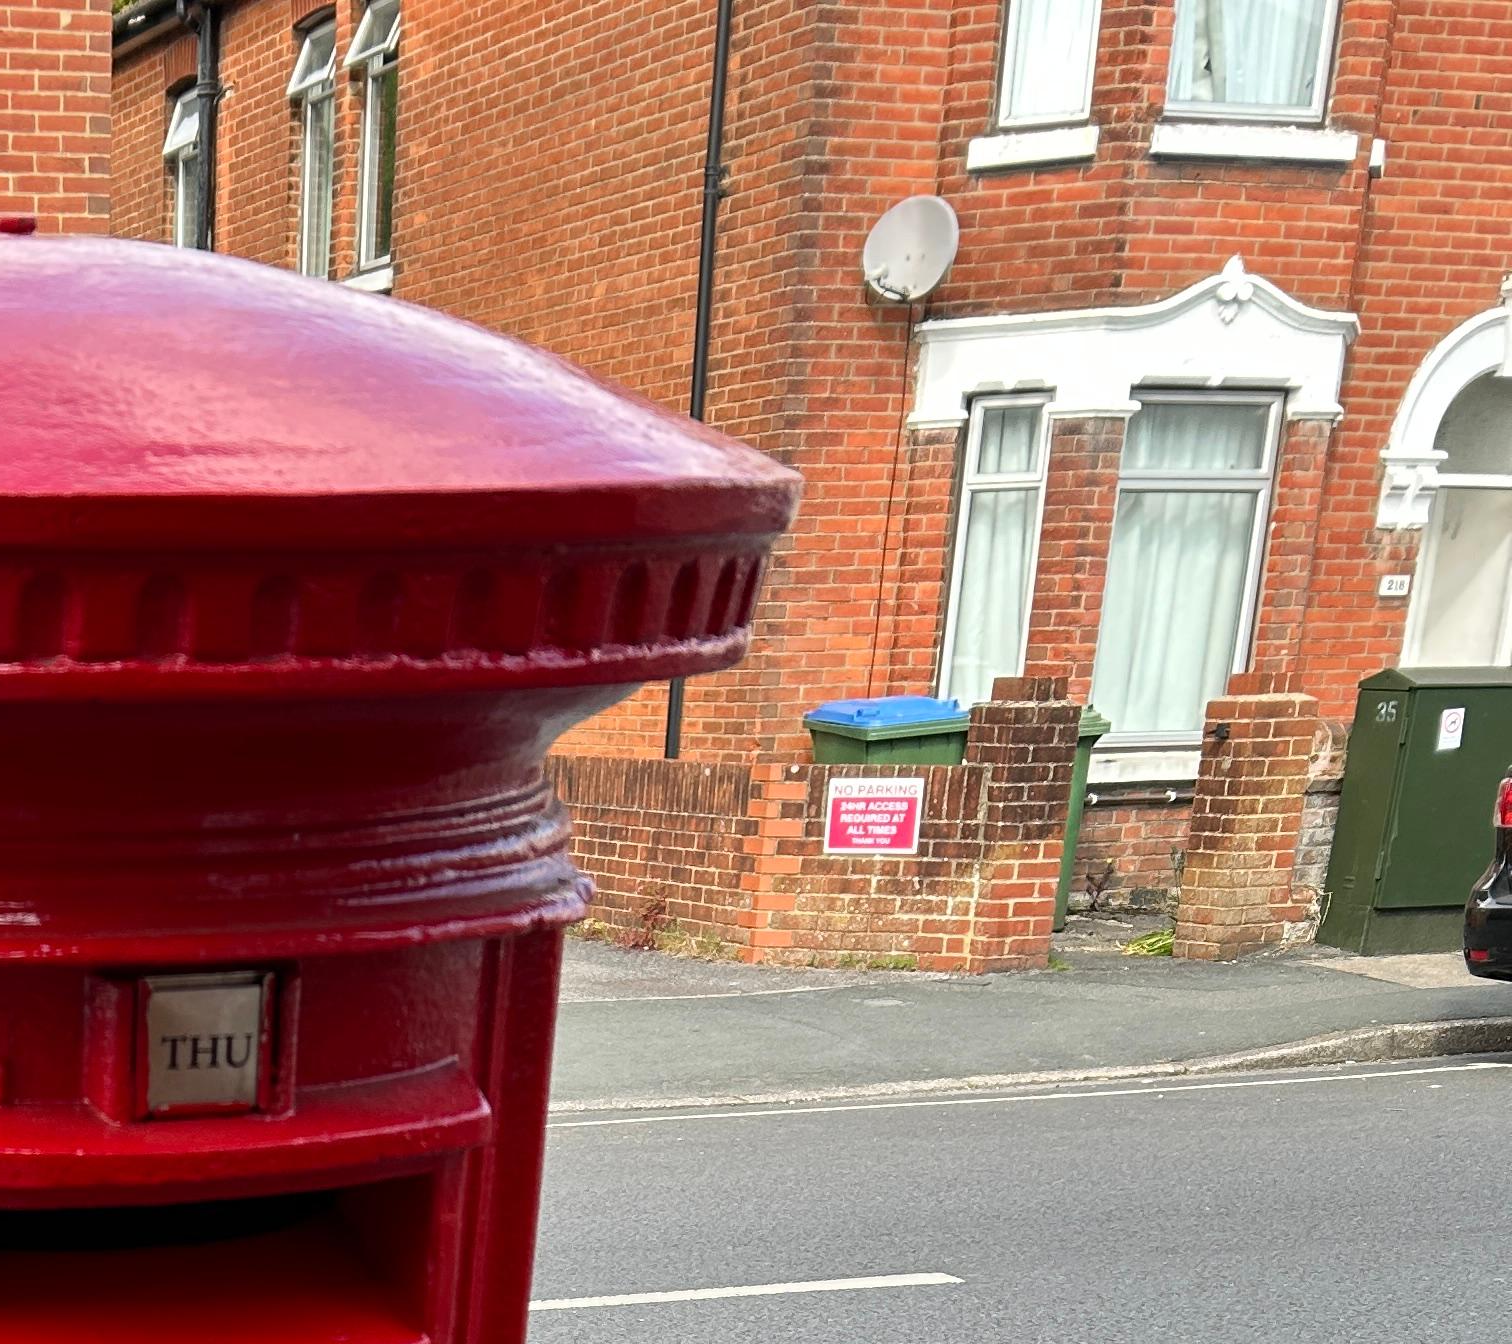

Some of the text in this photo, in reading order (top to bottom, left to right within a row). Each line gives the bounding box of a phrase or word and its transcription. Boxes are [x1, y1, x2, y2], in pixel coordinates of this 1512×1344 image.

[1387, 579, 1405, 591] 218
[1376, 700, 1399, 722] 35
[834, 785, 918, 795] NO PARKING
[867, 801, 909, 811] ACCESS
[840, 813, 906, 823] REQUIRED AT
[846, 825, 897, 835] ALL TIMES
[160, 1032, 253, 1070] THU
